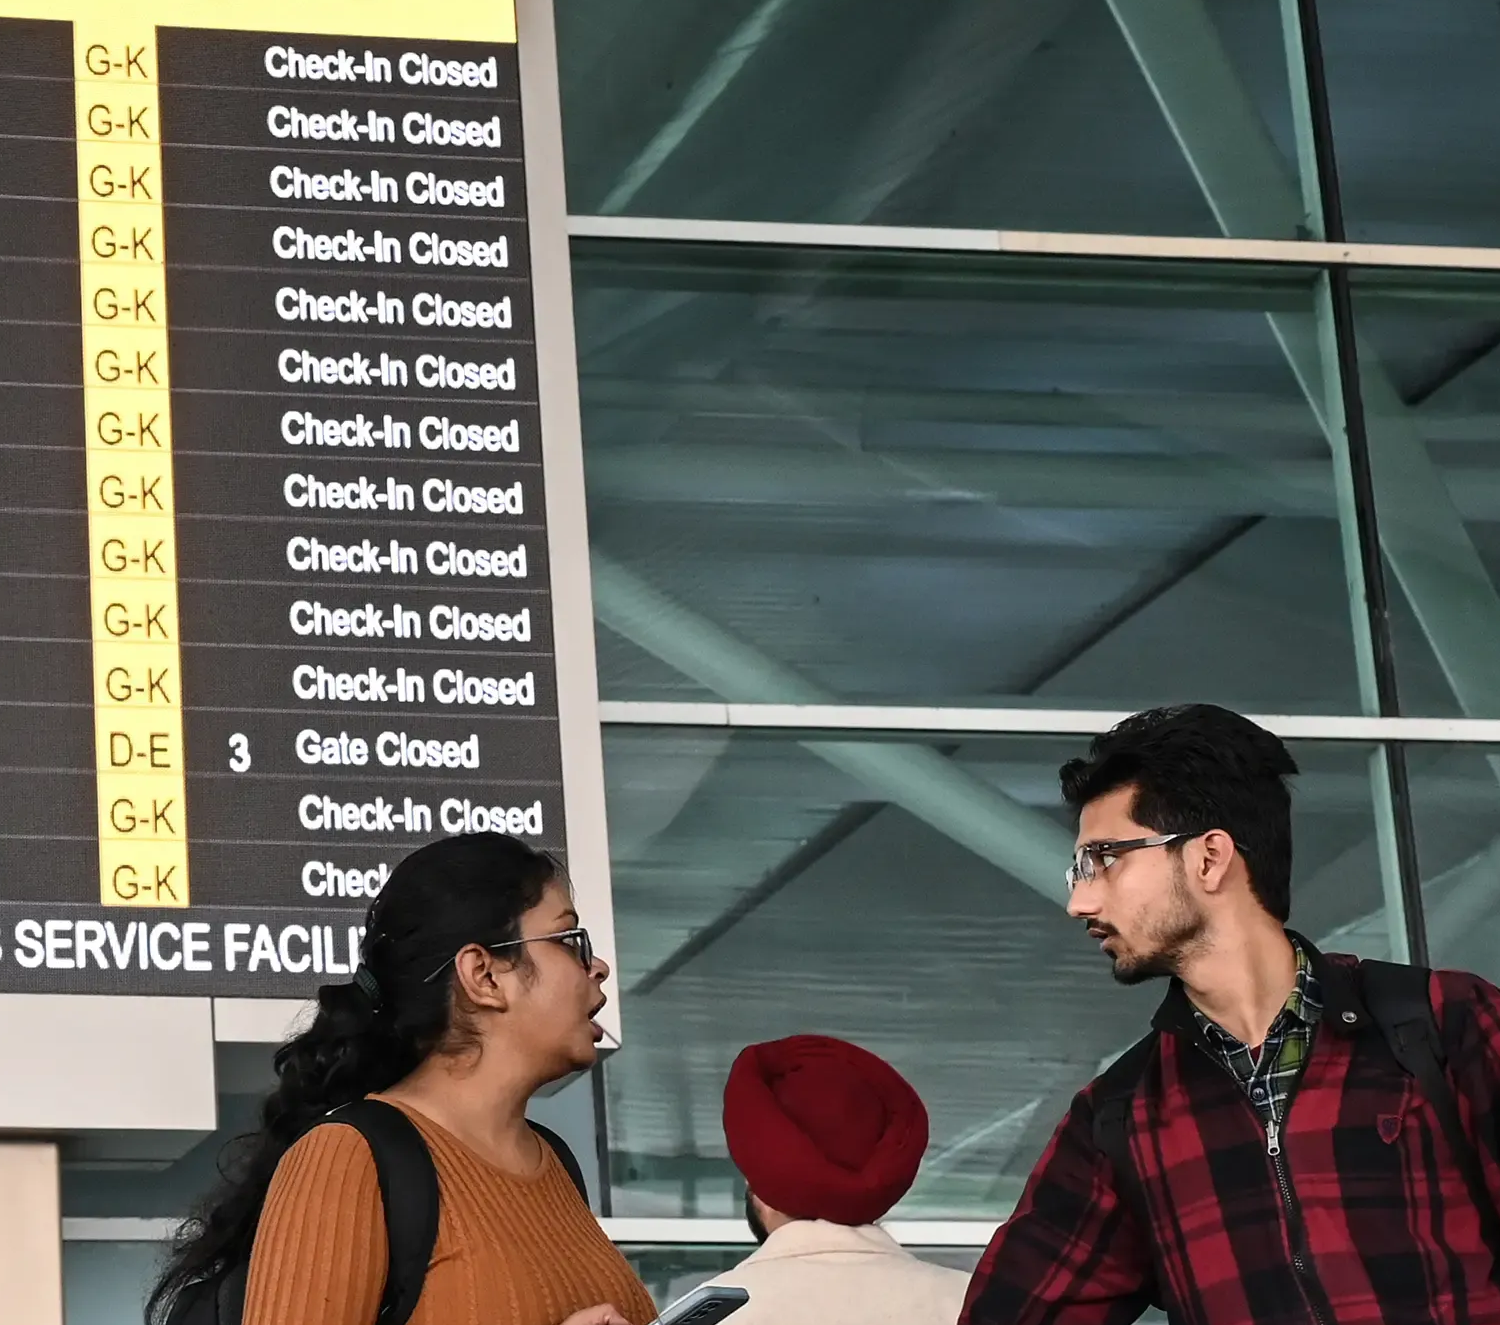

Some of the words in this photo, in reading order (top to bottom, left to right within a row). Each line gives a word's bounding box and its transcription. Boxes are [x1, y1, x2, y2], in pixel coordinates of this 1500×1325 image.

[86, 45, 147, 77] G-K
[265, 46, 392, 82] Check-In
[399, 52, 497, 88] Closed
[89, 105, 148, 138] G-K
[267, 106, 395, 142] Check-In
[403, 112, 501, 147] Closed
[90, 165, 151, 199] G-K
[270, 166, 398, 203] Check-In
[406, 172, 504, 207] Closed
[92, 226, 153, 260] G-K
[273, 226, 401, 263] Check-In
[409, 232, 508, 267] Closed
[94, 288, 155, 321] G-K
[275, 287, 404, 324] Check-In
[412, 293, 512, 328] Closed
[96, 350, 157, 383] G-K
[278, 349, 408, 387] Check-In
[416, 354, 516, 390] Closed
[98, 412, 160, 447] G-K
[281, 411, 411, 448] Check-In
[419, 416, 519, 452] Closed
[100, 476, 162, 509] G-K
[284, 473, 414, 511] Check-In
[422, 478, 523, 514] Closed
[102, 539, 164, 573] G-K
[286, 537, 418, 574] Check-In
[426, 541, 527, 577] Closed
[105, 603, 166, 636] G-K
[290, 601, 421, 638] Check-In
[429, 605, 531, 642] Closed
[107, 667, 169, 703] G-K
[292, 665, 425, 702] Check-In
[433, 669, 535, 705] Closed
[110, 733, 170, 768] D-E
[229, 733, 251, 772] 3
[296, 729, 368, 765] Gate
[376, 732, 479, 768] Closed
[111, 799, 174, 833] G-K
[298, 794, 432, 832] Check-In
[440, 798, 543, 835] Closed
[114, 865, 176, 900] G-K
[14, 919, 212, 971] SERVICE
[224, 923, 367, 974] FACILI
